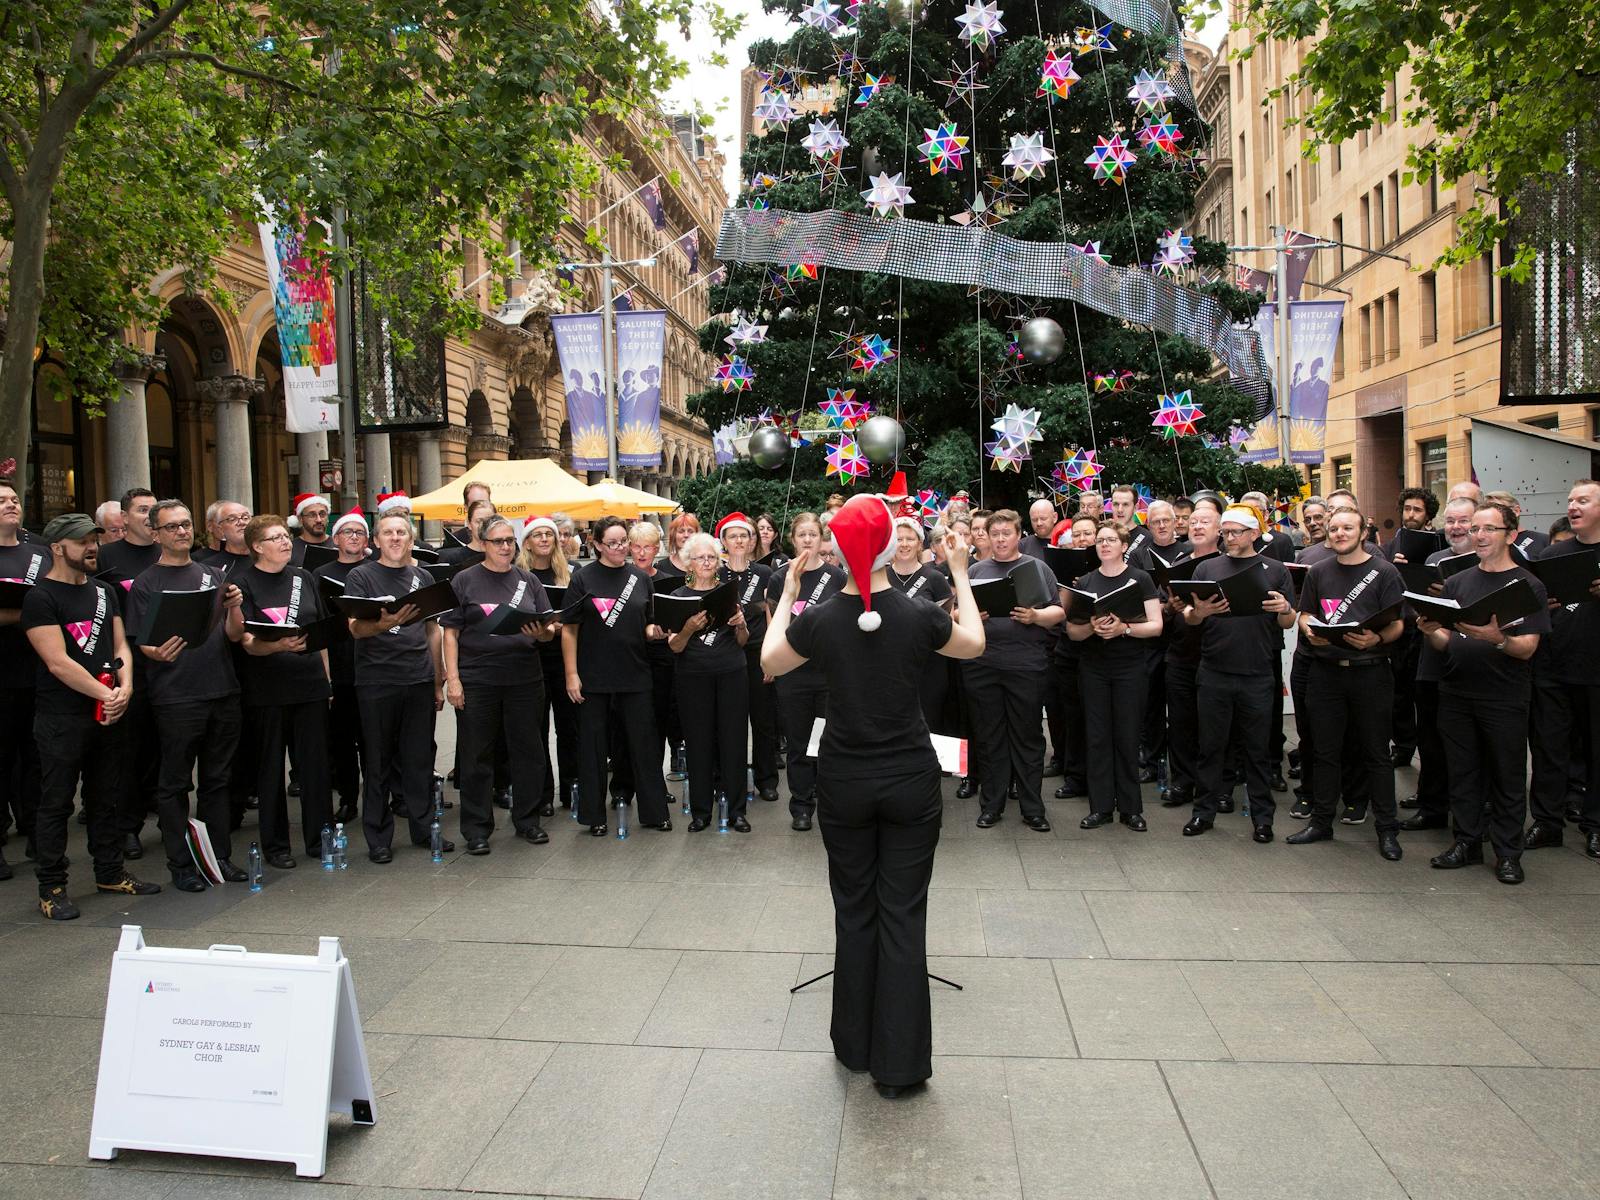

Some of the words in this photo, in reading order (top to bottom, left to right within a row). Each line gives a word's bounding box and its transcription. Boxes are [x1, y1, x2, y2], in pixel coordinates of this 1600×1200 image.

[556, 323, 599, 333] SALUTING
[620, 320, 662, 329] SALUTING
[566, 334, 593, 343] THEIR
[628, 331, 655, 339] THEIR
[562, 345, 599, 354] SERVICE
[623, 342, 661, 350] SERVICE
[810, 582, 826, 601] LESBIAN
[819, 572, 831, 585] CHOIR
[1338, 601, 1349, 613] GAY
[1346, 581, 1368, 601] LESBIAN
[1362, 569, 1379, 584] CHOIR
[83, 634, 98, 655] SYDNEY
[172, 1018, 199, 1026] CAROLS
[200, 1019, 242, 1029] PERFORMED
[159, 1039, 194, 1049] SYDNEY
[195, 1041, 215, 1050] GAY
[216, 1043, 223, 1051] &
[224, 1042, 261, 1053] LESBIAN
[194, 1053, 223, 1063] CHOIR
